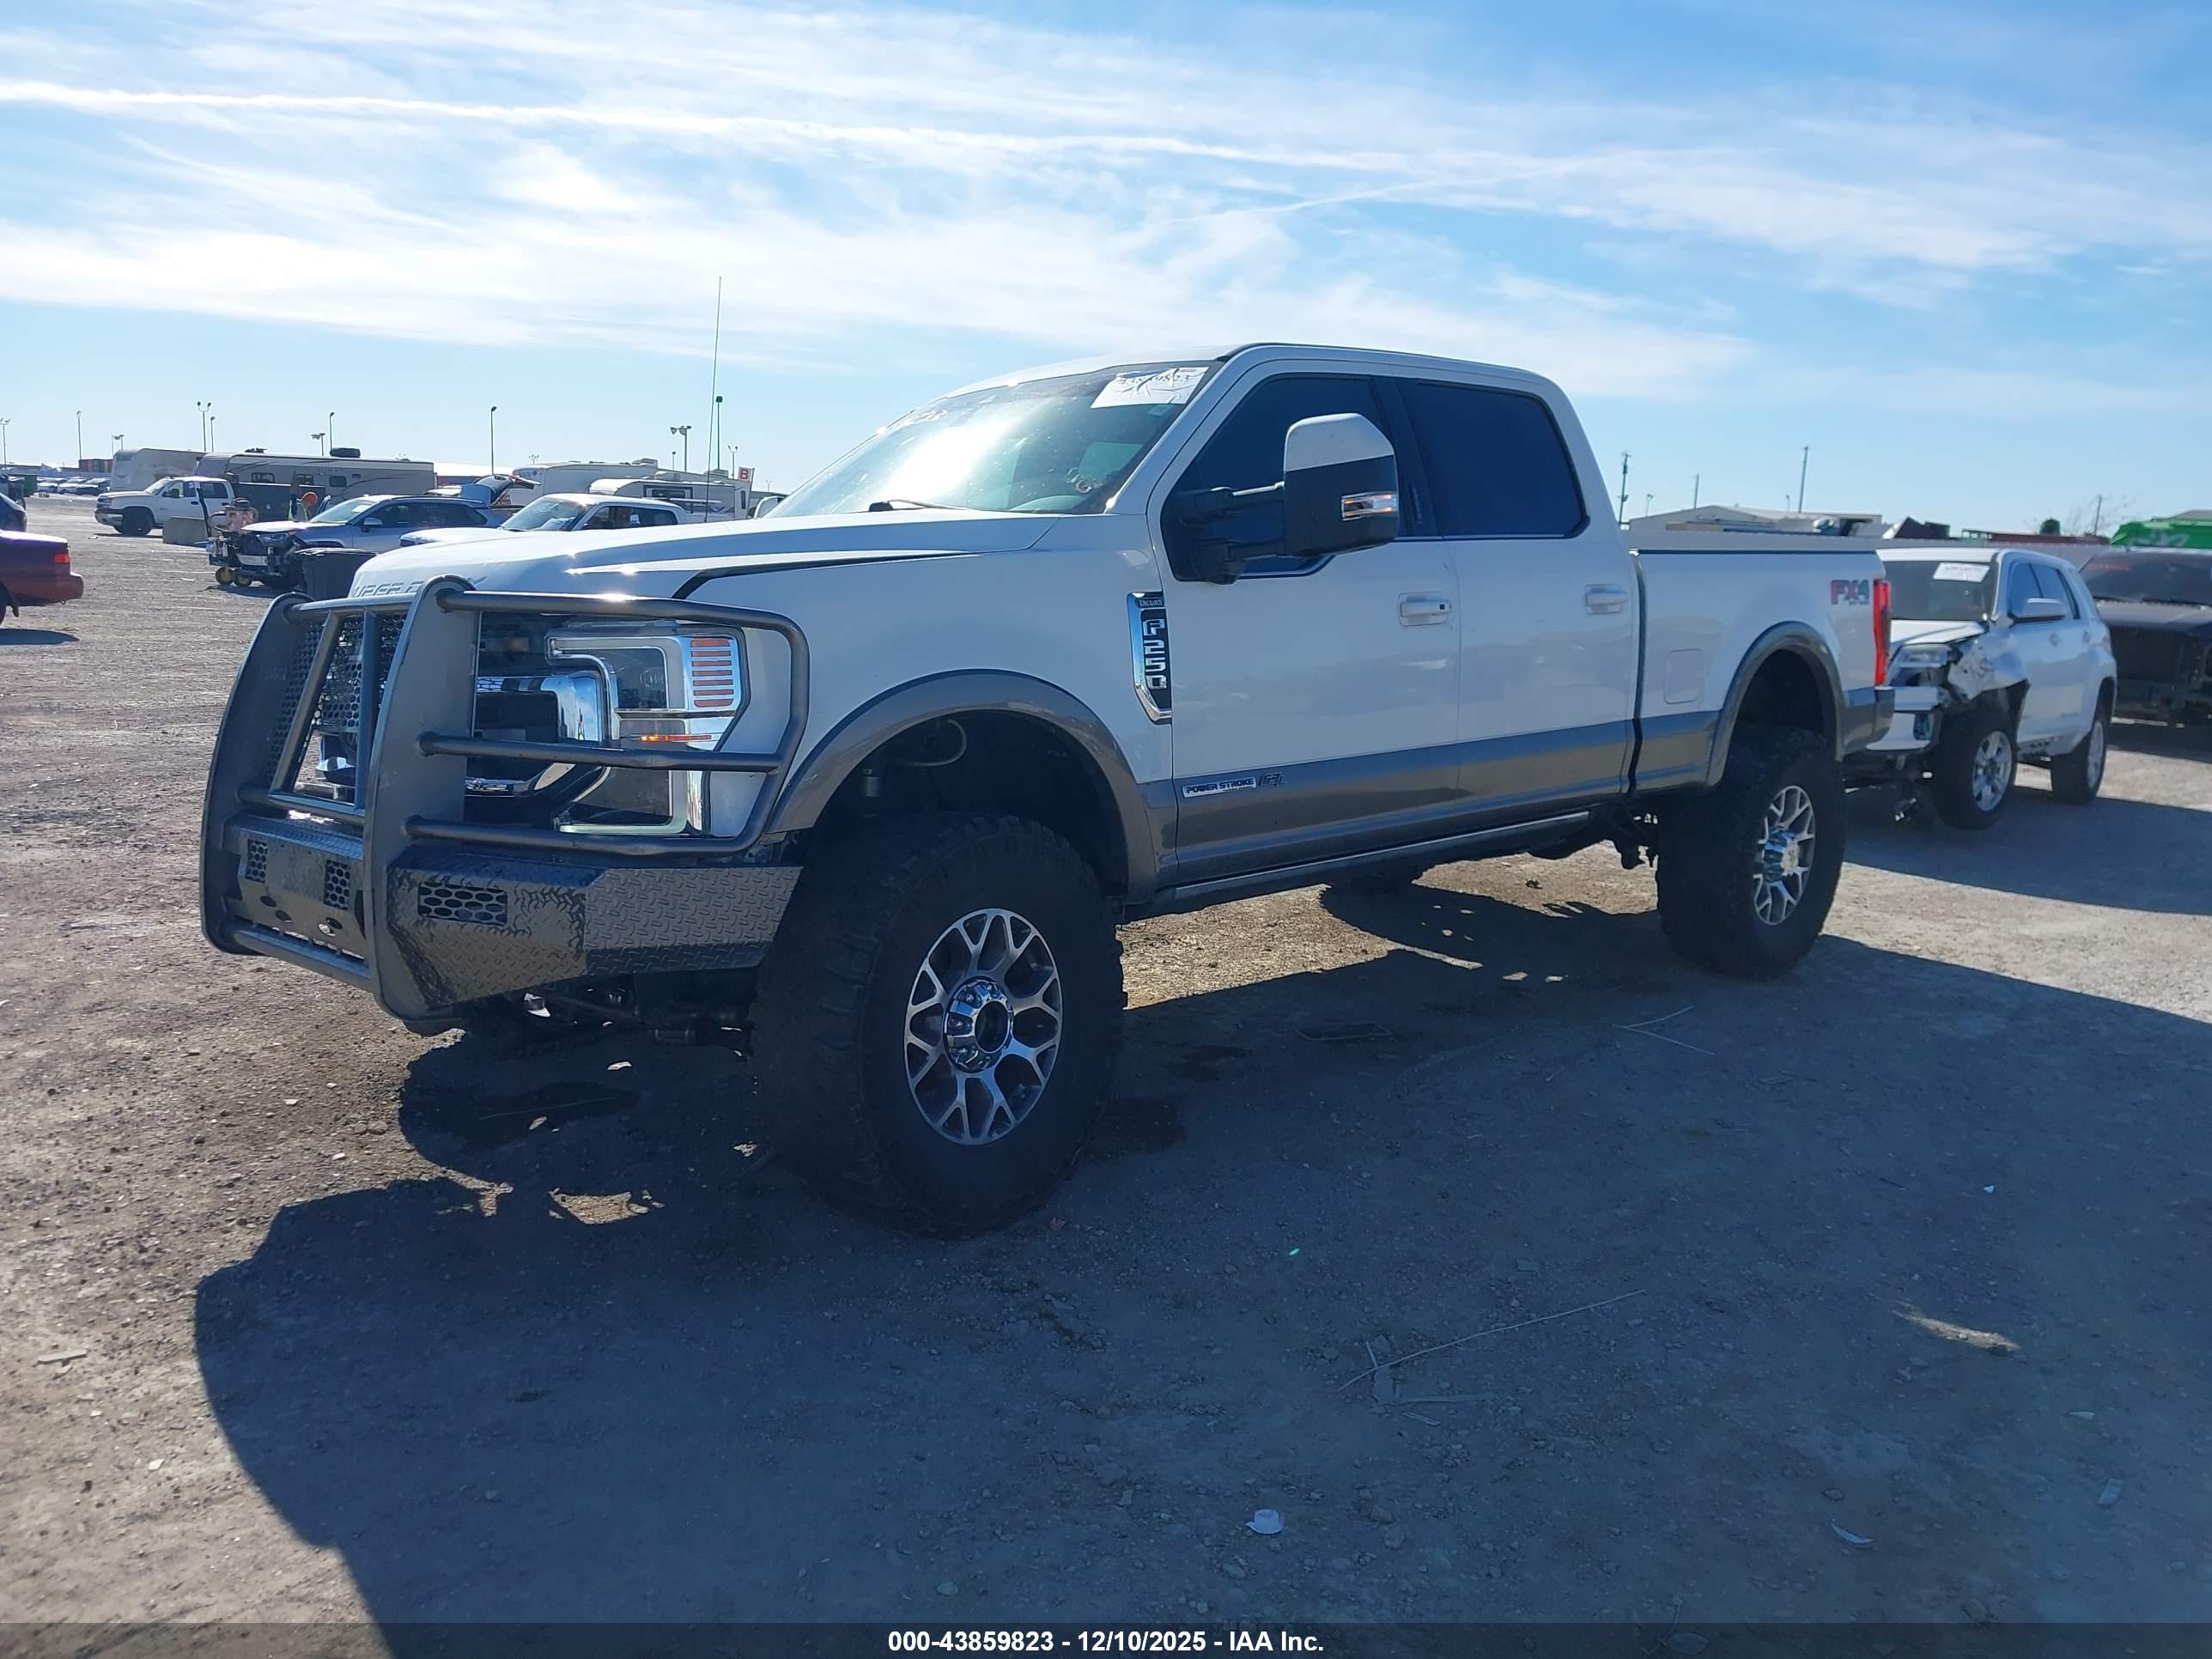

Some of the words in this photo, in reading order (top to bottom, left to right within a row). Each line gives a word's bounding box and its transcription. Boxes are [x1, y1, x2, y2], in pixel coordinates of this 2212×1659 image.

[740, 468, 749, 479] B
[1831, 579, 1870, 605] FX4
[1186, 782, 1218, 794] POWER
[1219, 778, 1255, 789] STROKE
